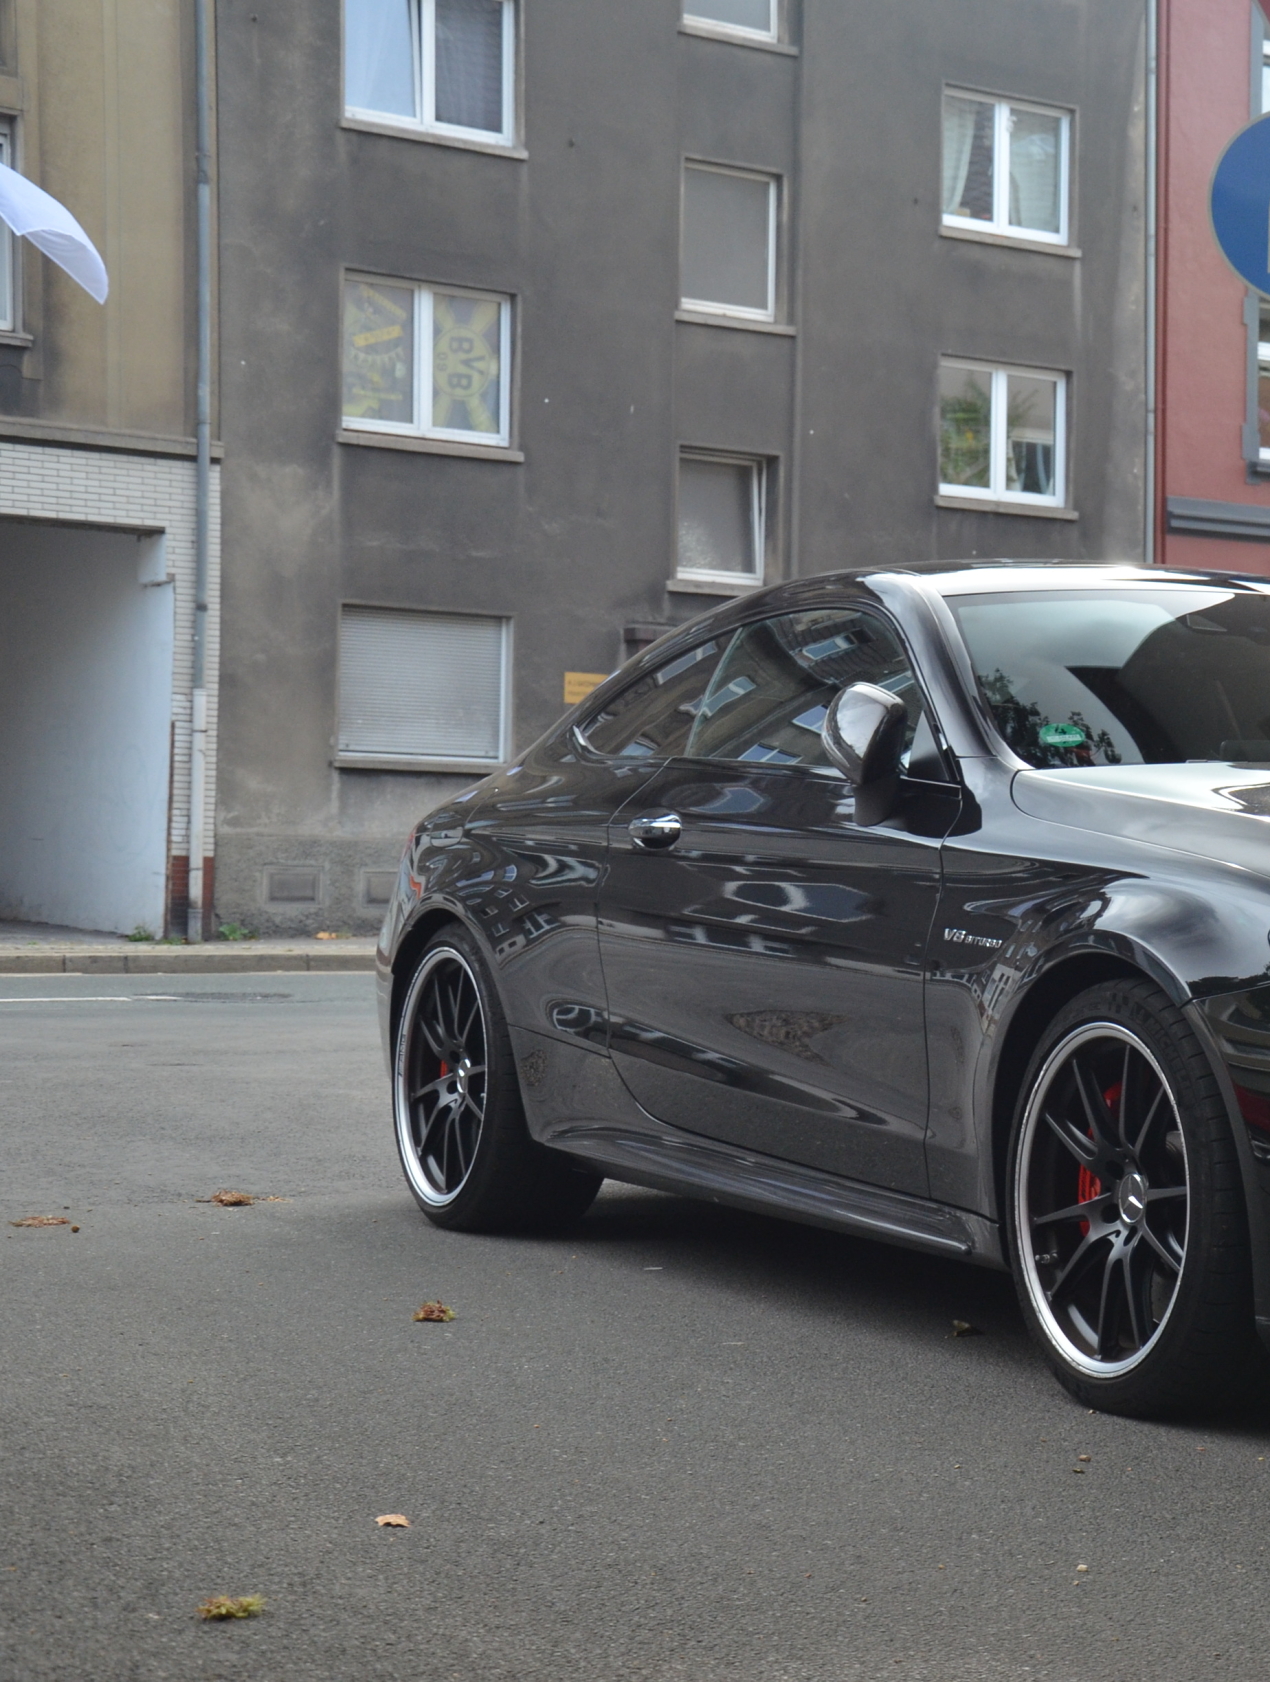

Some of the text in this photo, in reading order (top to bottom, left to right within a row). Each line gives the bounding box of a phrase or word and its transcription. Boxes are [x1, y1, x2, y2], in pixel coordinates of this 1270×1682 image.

[436, 351, 448, 372] 09
[449, 336, 485, 391] BVB
[944, 928, 966, 943] V8
